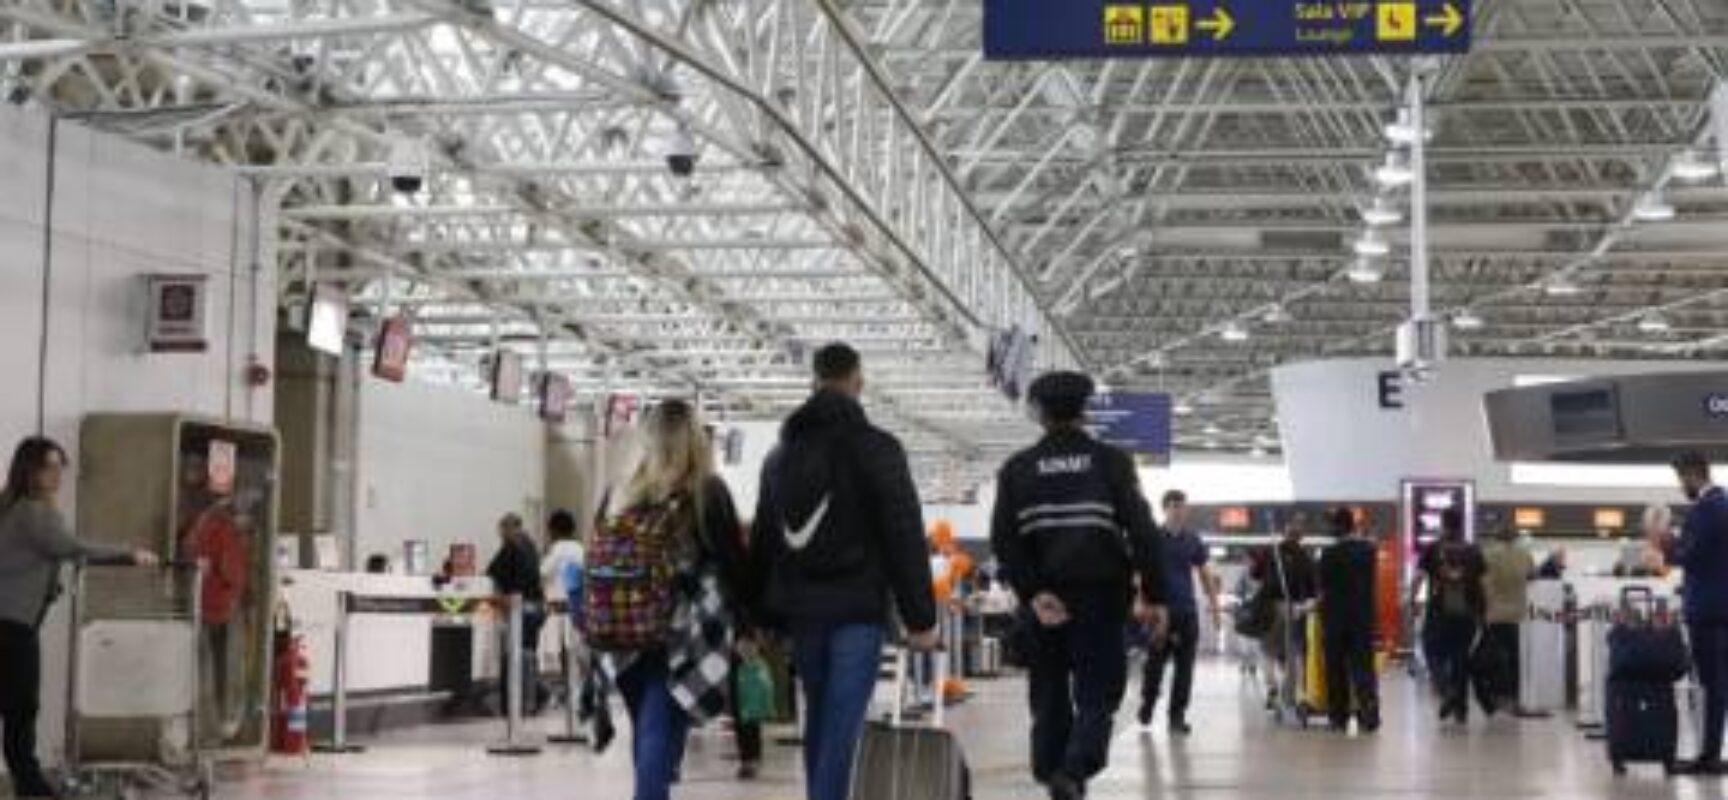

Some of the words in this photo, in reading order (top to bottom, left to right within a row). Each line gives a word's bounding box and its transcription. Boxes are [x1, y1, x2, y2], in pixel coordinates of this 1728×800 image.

[1295, 2, 1333, 19] Sala
[1337, 2, 1369, 19] VIP
[1378, 371, 1403, 408] E
